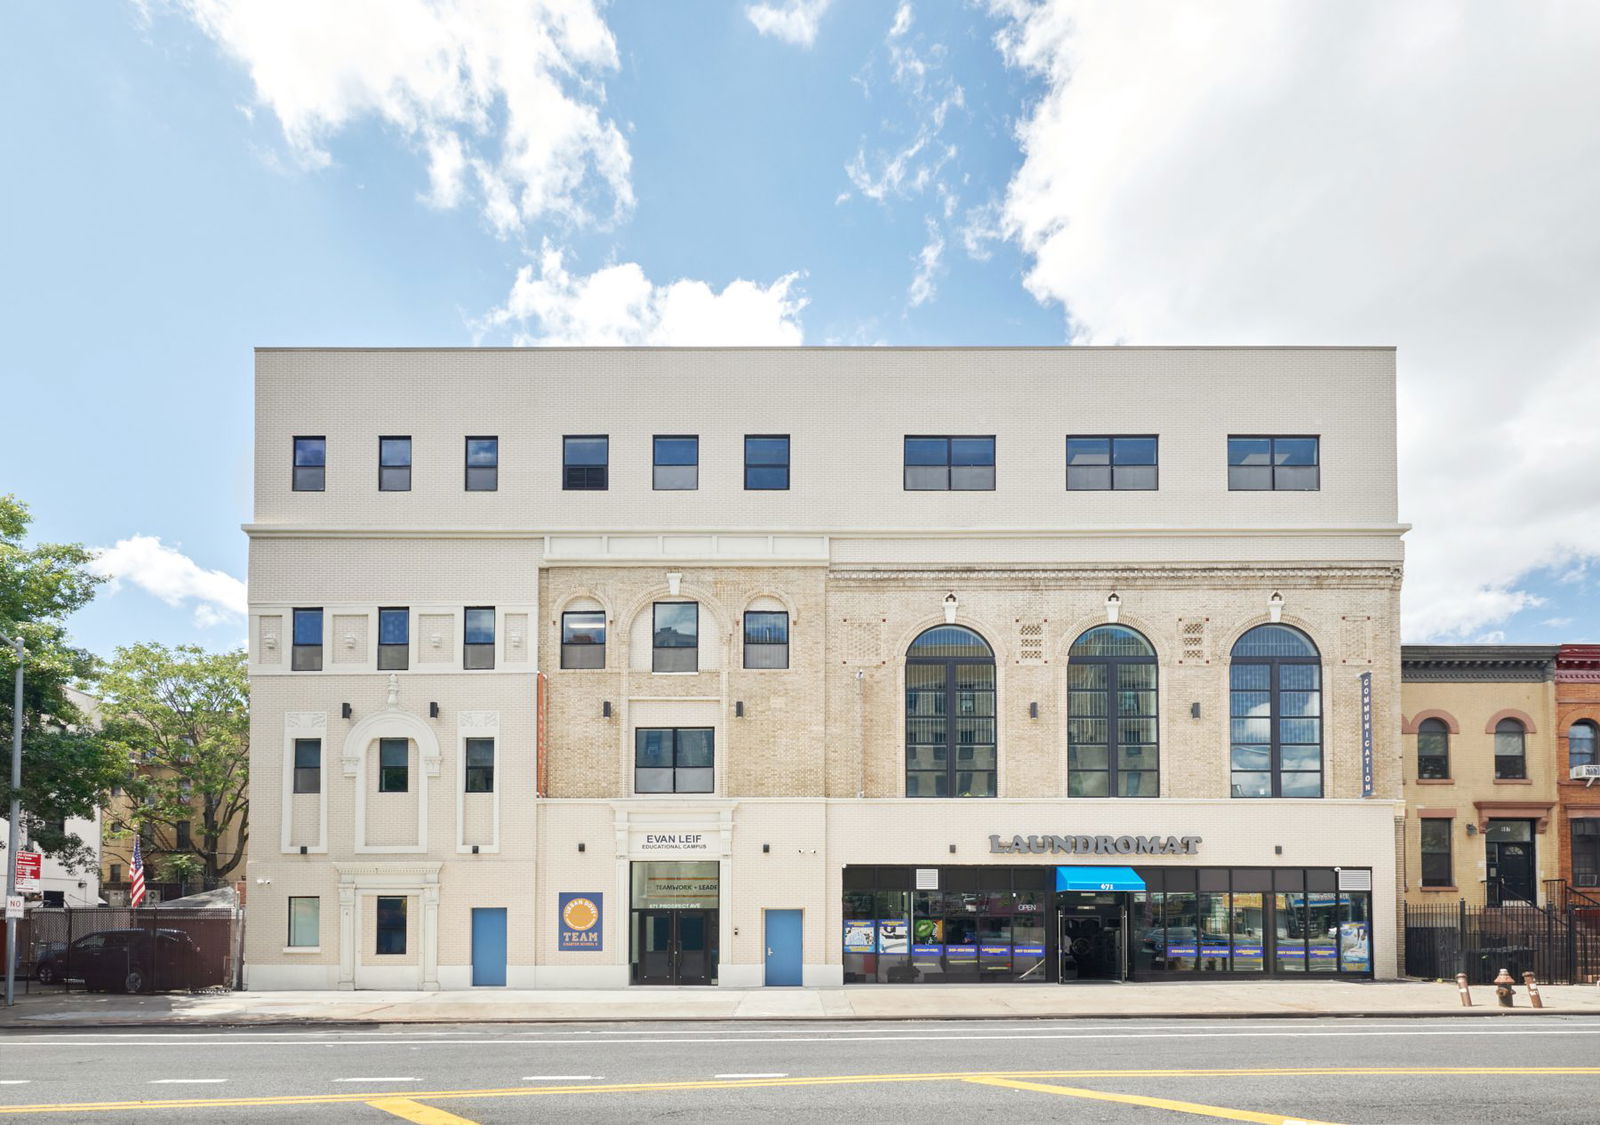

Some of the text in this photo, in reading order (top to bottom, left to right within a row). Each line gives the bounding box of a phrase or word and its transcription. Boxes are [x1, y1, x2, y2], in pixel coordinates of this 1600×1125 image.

[646, 834, 702, 844] EVAN LEIF
[988, 834, 1203, 855] LAUNDROMAT
[563, 932, 598, 941] TEAM
